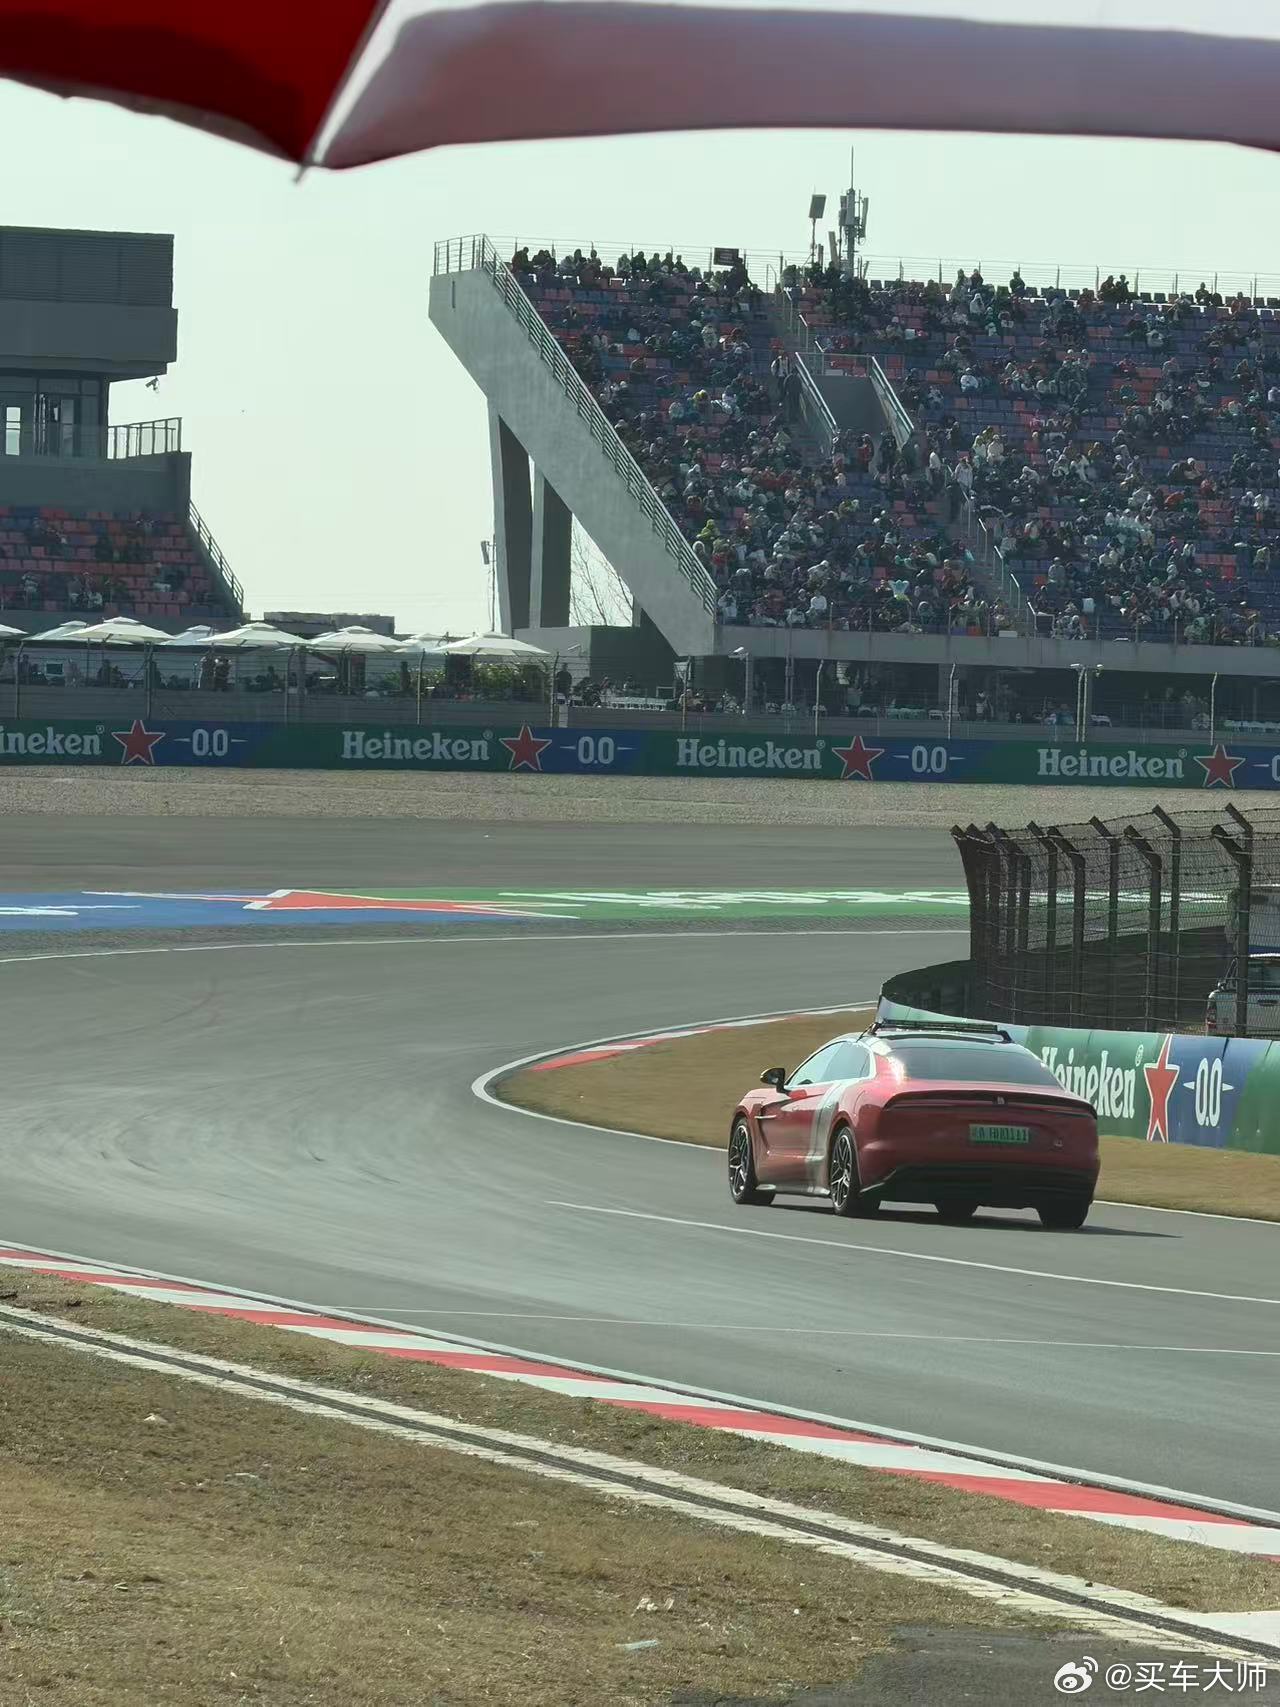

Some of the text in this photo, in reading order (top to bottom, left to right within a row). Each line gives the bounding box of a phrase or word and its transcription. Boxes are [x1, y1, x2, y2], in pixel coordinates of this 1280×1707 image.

[191, 728, 229, 757] 0.0
[341, 731, 615, 765] Heineken 0.0
[677, 738, 948, 774] Heineken 0.0
[1037, 749, 1185, 779] Heineken
[1195, 1057, 1223, 1127] 0.0
